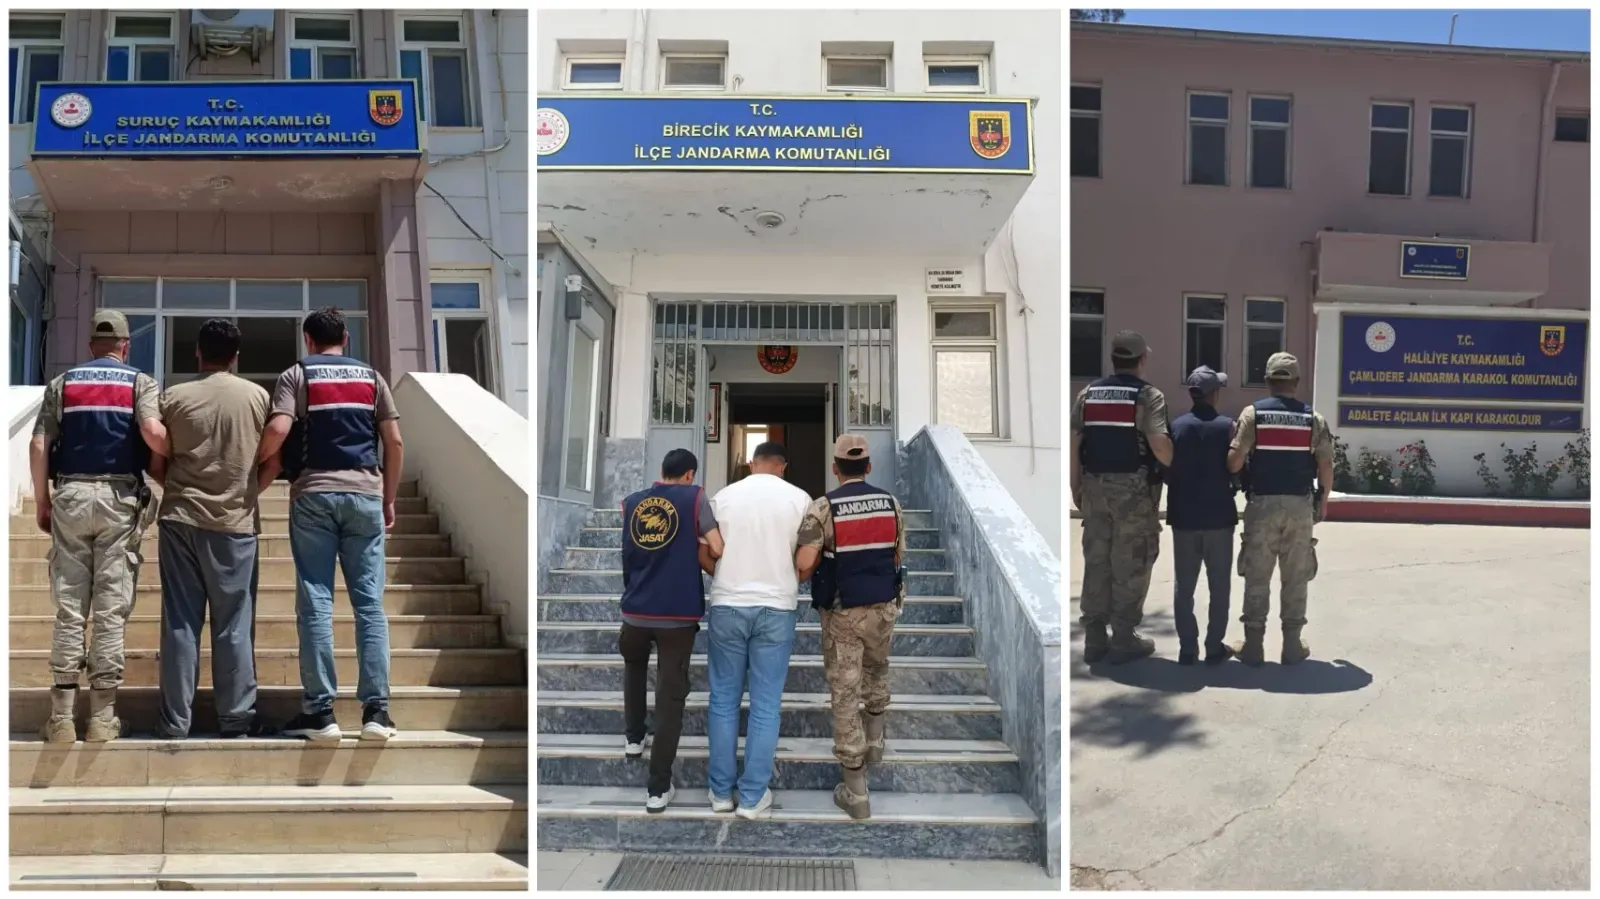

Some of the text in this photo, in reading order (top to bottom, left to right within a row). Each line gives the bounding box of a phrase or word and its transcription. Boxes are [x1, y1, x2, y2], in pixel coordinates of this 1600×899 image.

[208, 99, 244, 109] T.C.
[750, 104, 777, 116] T.C.
[117, 113, 331, 128] SURUÇ KAYMAKAMLIĞI
[663, 122, 863, 138] BİRECİK KAYMAKAMLIĞI
[84, 130, 376, 146] İLÇE JANDARMA KOMUTANLIĞI
[635, 144, 890, 161] İLÇE JANDARMA KOMUTANLIĞI
[1457, 335, 1474, 346] T.C.
[1403, 351, 1525, 366] HALİLİYE KAYMAKAMLIĞI
[71, 370, 129, 382] JANDARMA
[314, 368, 371, 379] JANDARMA
[1349, 371, 1577, 386] ÇAMLIDERE JANDARMA KARAKOL KOMUTANLIĞI
[1348, 410, 1542, 425] ADALETE AÇILAN İLK KAPI KARAKOLDUR
[635, 498, 675, 516] JANDARMA
[836, 499, 892, 516] JANDARMA
[639, 534, 666, 543] JASAT
